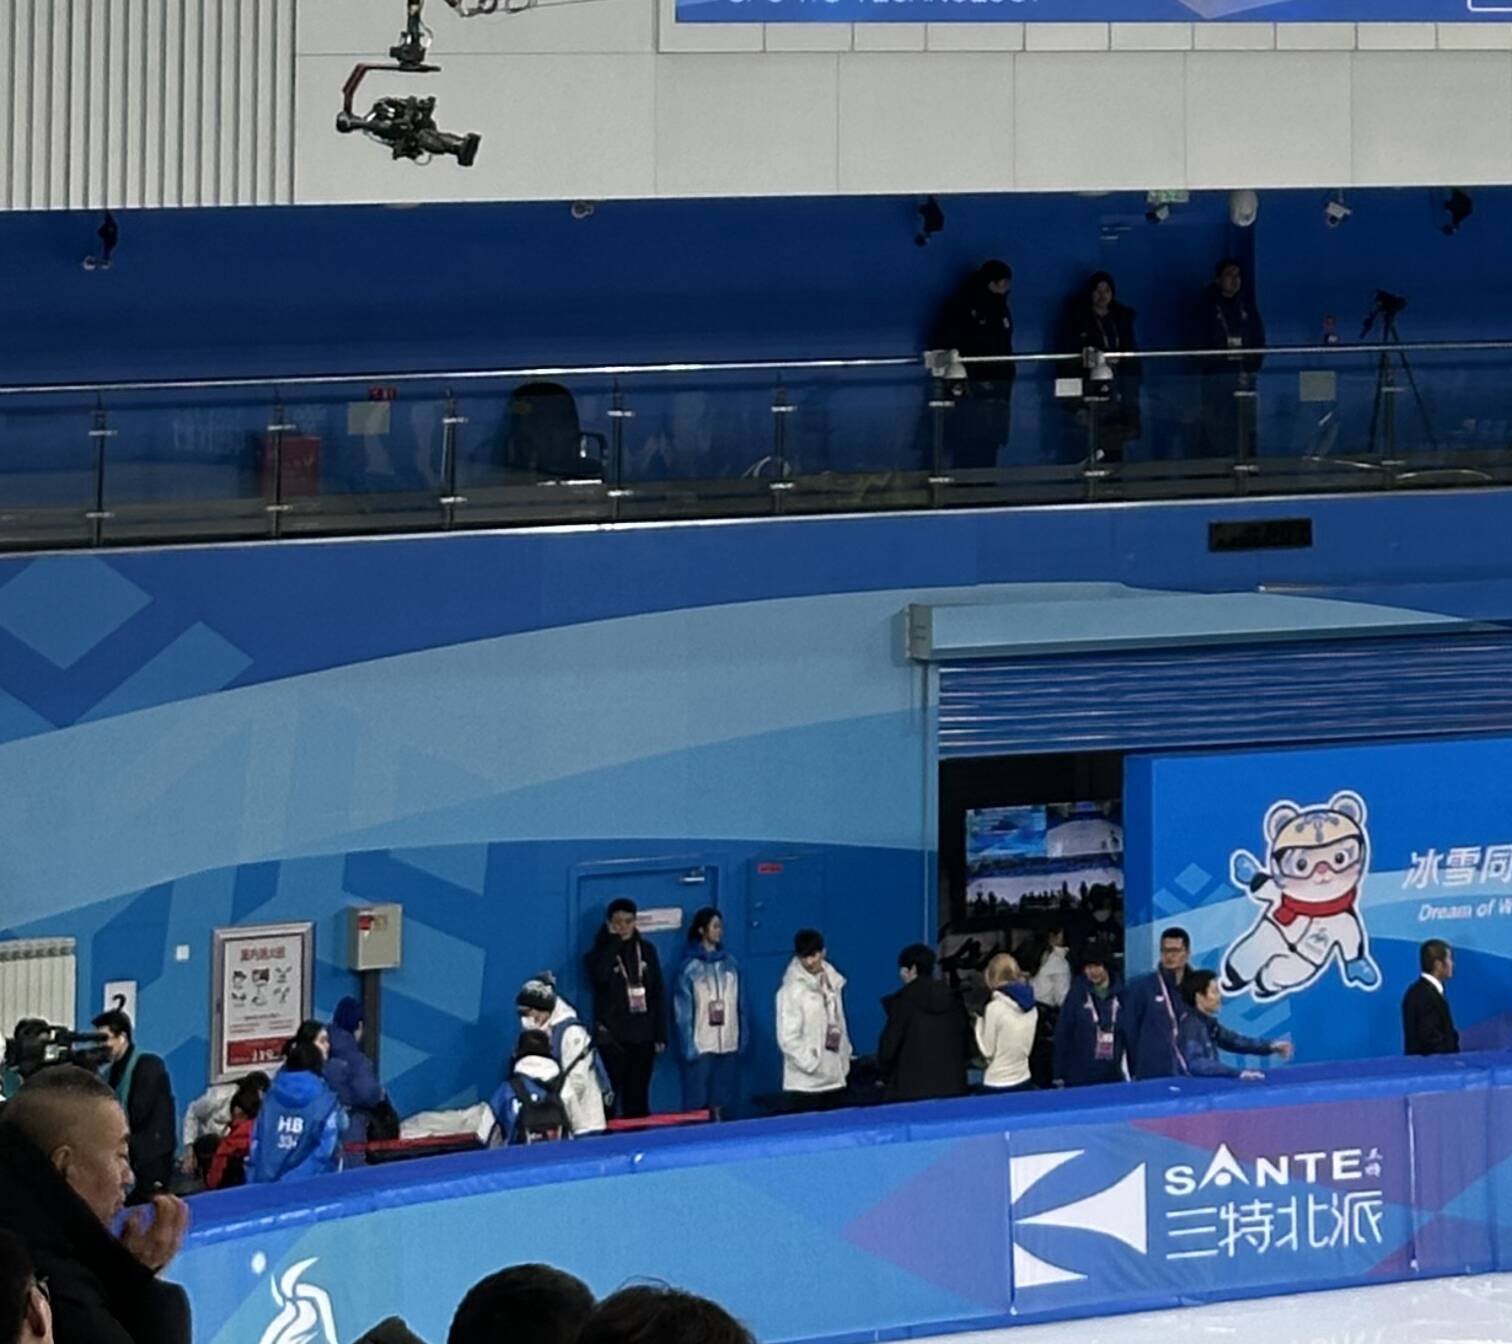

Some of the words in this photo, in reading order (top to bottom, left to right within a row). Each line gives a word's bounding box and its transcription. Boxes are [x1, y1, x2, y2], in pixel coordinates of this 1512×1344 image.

[1418, 902, 1472, 921] Dream
[1477, 899, 1496, 918] of
[1164, 1143, 1362, 1196] SANTE
[1166, 1190, 1383, 1260] 三特北派
